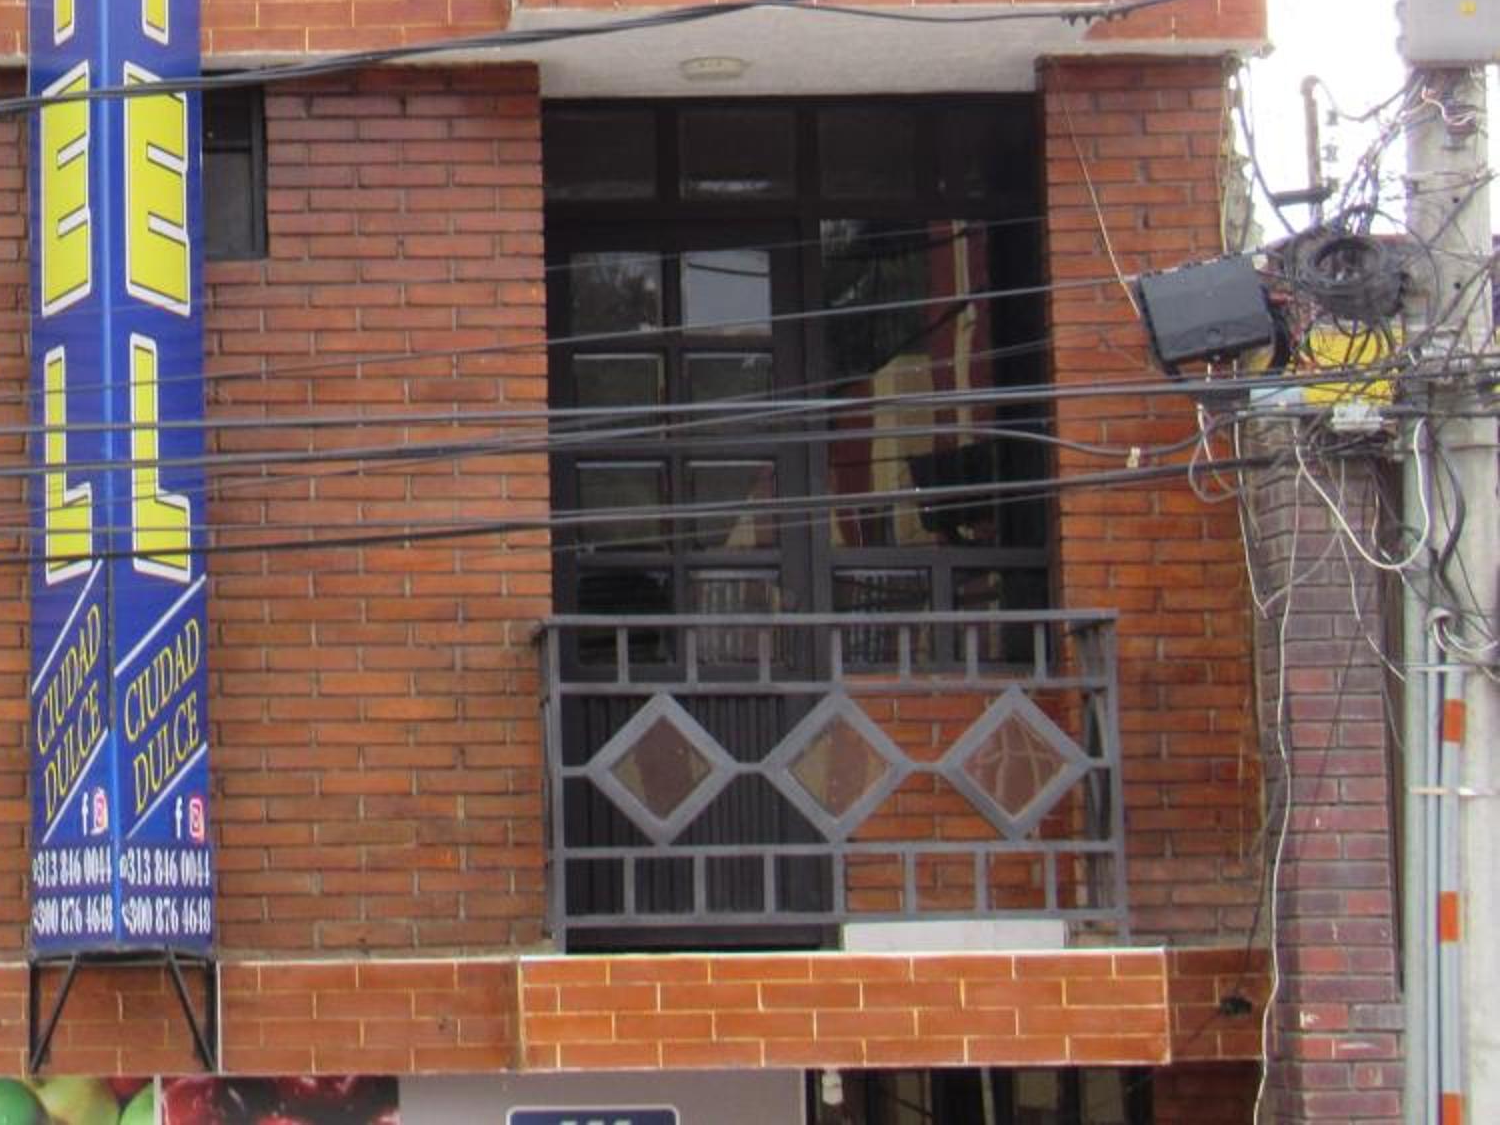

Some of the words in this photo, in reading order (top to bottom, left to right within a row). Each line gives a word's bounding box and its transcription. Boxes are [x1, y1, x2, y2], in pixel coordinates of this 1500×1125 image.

[37, 604, 101, 756] CIUDAD
[124, 618, 199, 742] CIUDAD
[45, 679, 101, 823] DULCE
[133, 691, 199, 815] DULCE
[37, 850, 58, 887] 313
[127, 847, 151, 886] 313
[61, 895, 83, 935] 876
[155, 896, 179, 935] 876
